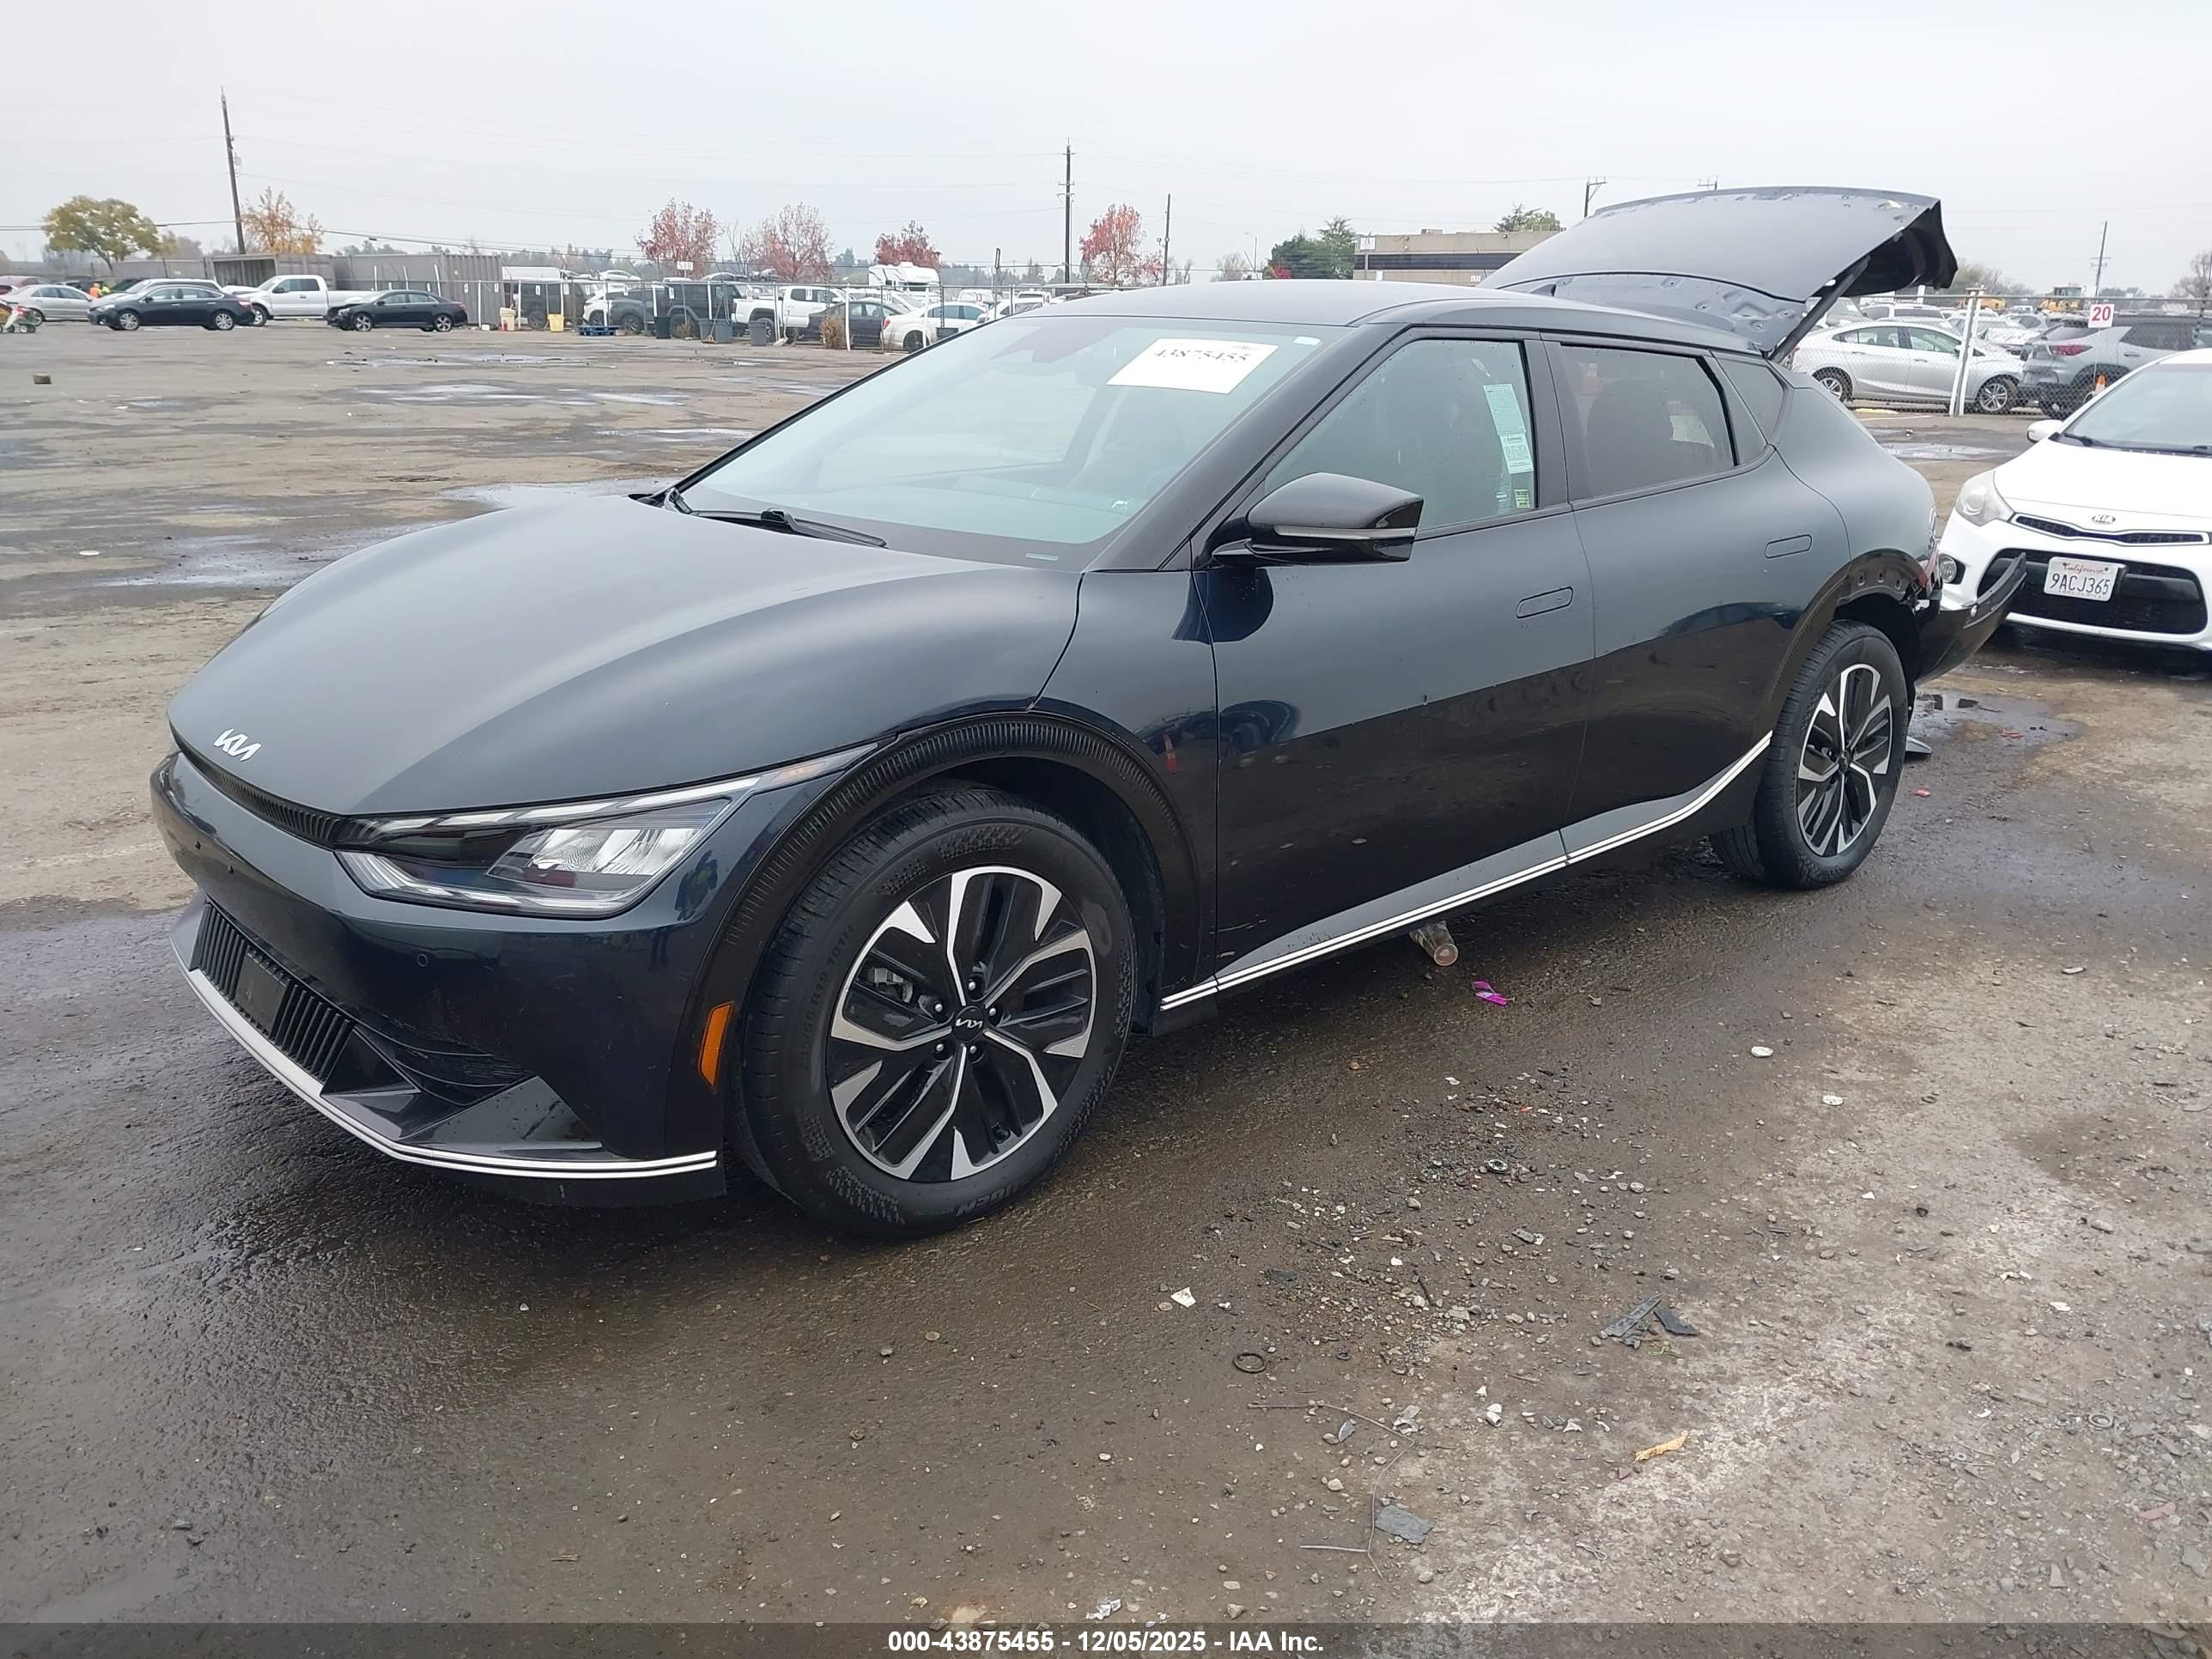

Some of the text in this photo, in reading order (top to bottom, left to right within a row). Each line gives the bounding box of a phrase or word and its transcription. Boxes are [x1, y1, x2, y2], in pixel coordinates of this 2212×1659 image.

[2091, 306, 2111, 321] 20
[2063, 562, 2105, 574] California
[2050, 573, 2111, 595] 9ACJ365
